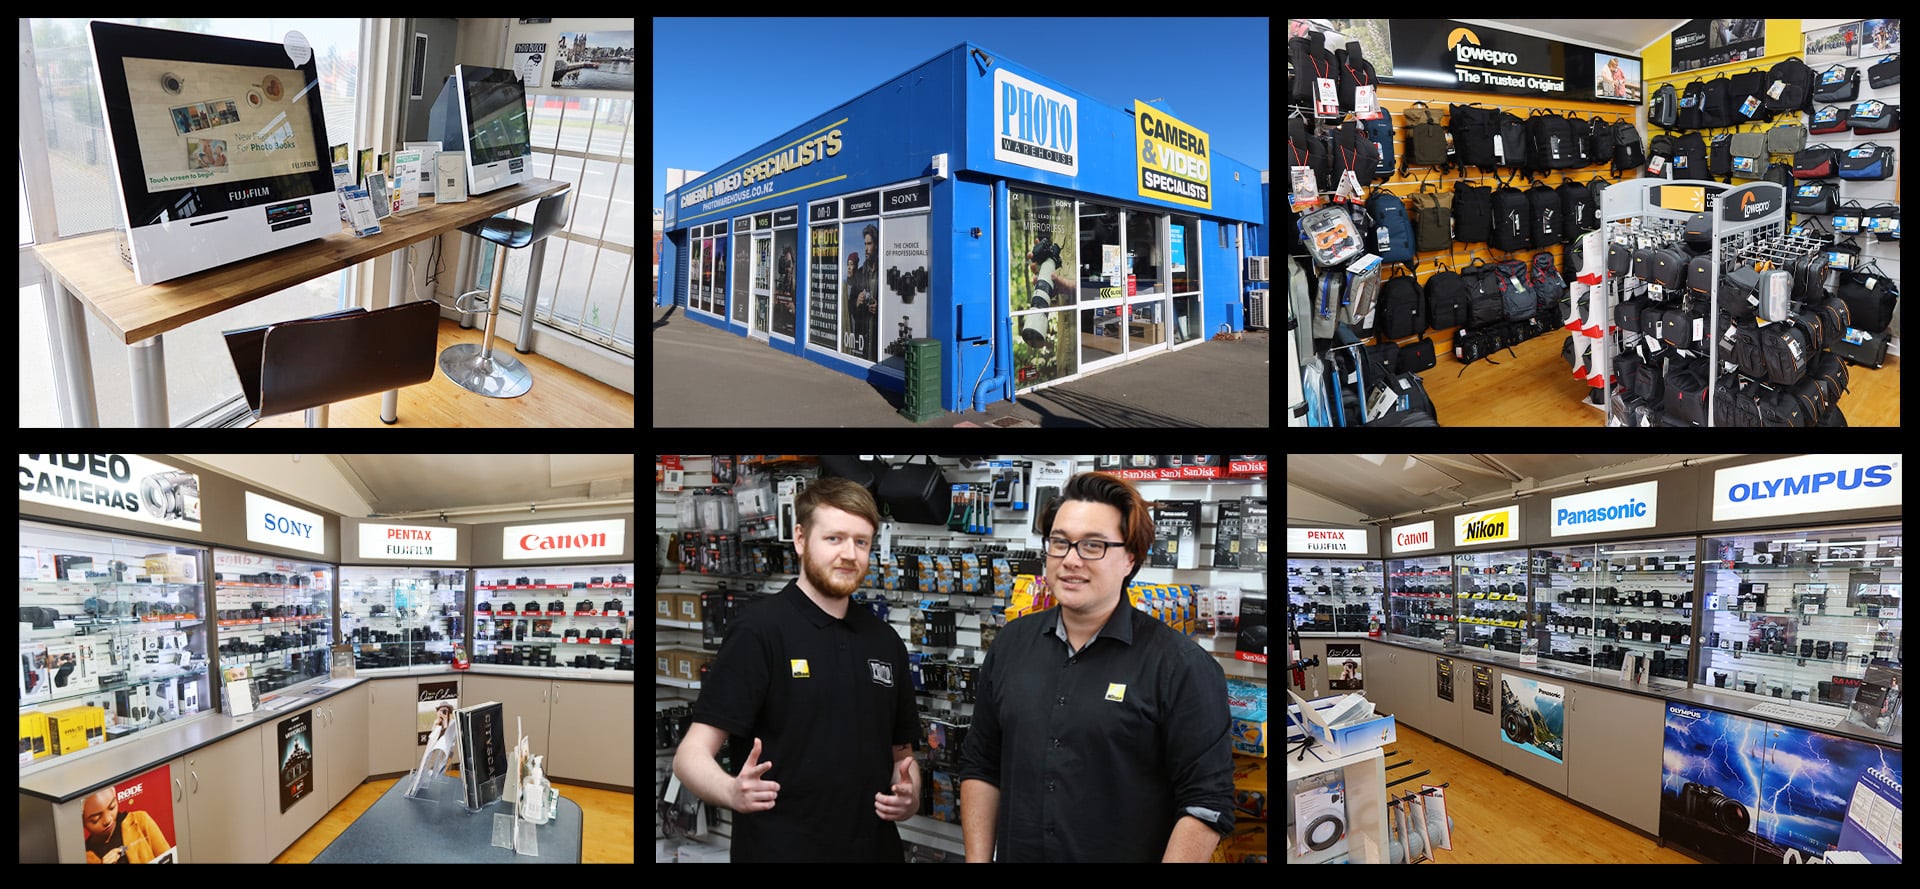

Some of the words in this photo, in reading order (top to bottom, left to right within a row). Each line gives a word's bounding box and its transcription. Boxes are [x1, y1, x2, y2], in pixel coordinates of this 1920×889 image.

[1456, 43, 1518, 66] Lowepro
[1455, 68, 1481, 83] The
[1481, 72, 1526, 88] Trusted
[1527, 77, 1565, 92] Original
[1000, 80, 1073, 154] PHOTO
[1140, 111, 1207, 158] CAMERA
[250, 142, 273, 151] Photo
[1002, 139, 1073, 166] WAREHOUSE
[1142, 139, 1157, 166] &
[1157, 143, 1209, 182] VIDEO
[680, 187, 708, 209] CAMERA
[707, 183, 714, 200] &
[713, 172, 742, 197] VIDEO
[742, 129, 843, 188] SPECIALISTS
[149, 176, 169, 184] Touch
[169, 174, 190, 182] screen
[197, 171, 214, 180] begin
[1143, 170, 1207, 201] SPECIALISTS
[228, 186, 270, 201] FUJIFILM
[702, 181, 774, 212] PHOTOWAREHOUSE.CO.NZ
[891, 192, 920, 205] SONY
[850, 200, 872, 211] OLYMPUS
[1055, 200, 1072, 208] SONY
[1744, 200, 1770, 219] Lowepro
[1023, 221, 1065, 234] MIRRORLESS
[902, 241, 919, 249] CHOICE
[892, 249, 929, 257] PROFESSIONALS
[843, 332, 865, 351] OM-D
[1183, 467, 1215, 477] SanDisk
[1231, 462, 1265, 472] SanDisk
[1122, 469, 1158, 479] SanDisk
[19, 466, 140, 513] CAMERAS
[1728, 464, 1893, 503] OLYMPUS
[1557, 498, 1647, 526] Panasonic
[264, 512, 313, 539] SONY
[1182, 526, 1192, 537] 16
[1466, 520, 1505, 540] Nikon
[387, 528, 432, 541] PENTAX
[1307, 531, 1345, 540] PENTAX
[1397, 531, 1429, 547] Canon
[519, 532, 607, 551] Canon
[1308, 543, 1347, 551] FUJIFILM
[386, 544, 433, 556] FUJIFILM
[1242, 652, 1268, 663] SanDisk
[1538, 687, 1562, 699] Panasonic
[1228, 698, 1248, 707] Kodak
[1669, 706, 1702, 719] OLYMPUS
